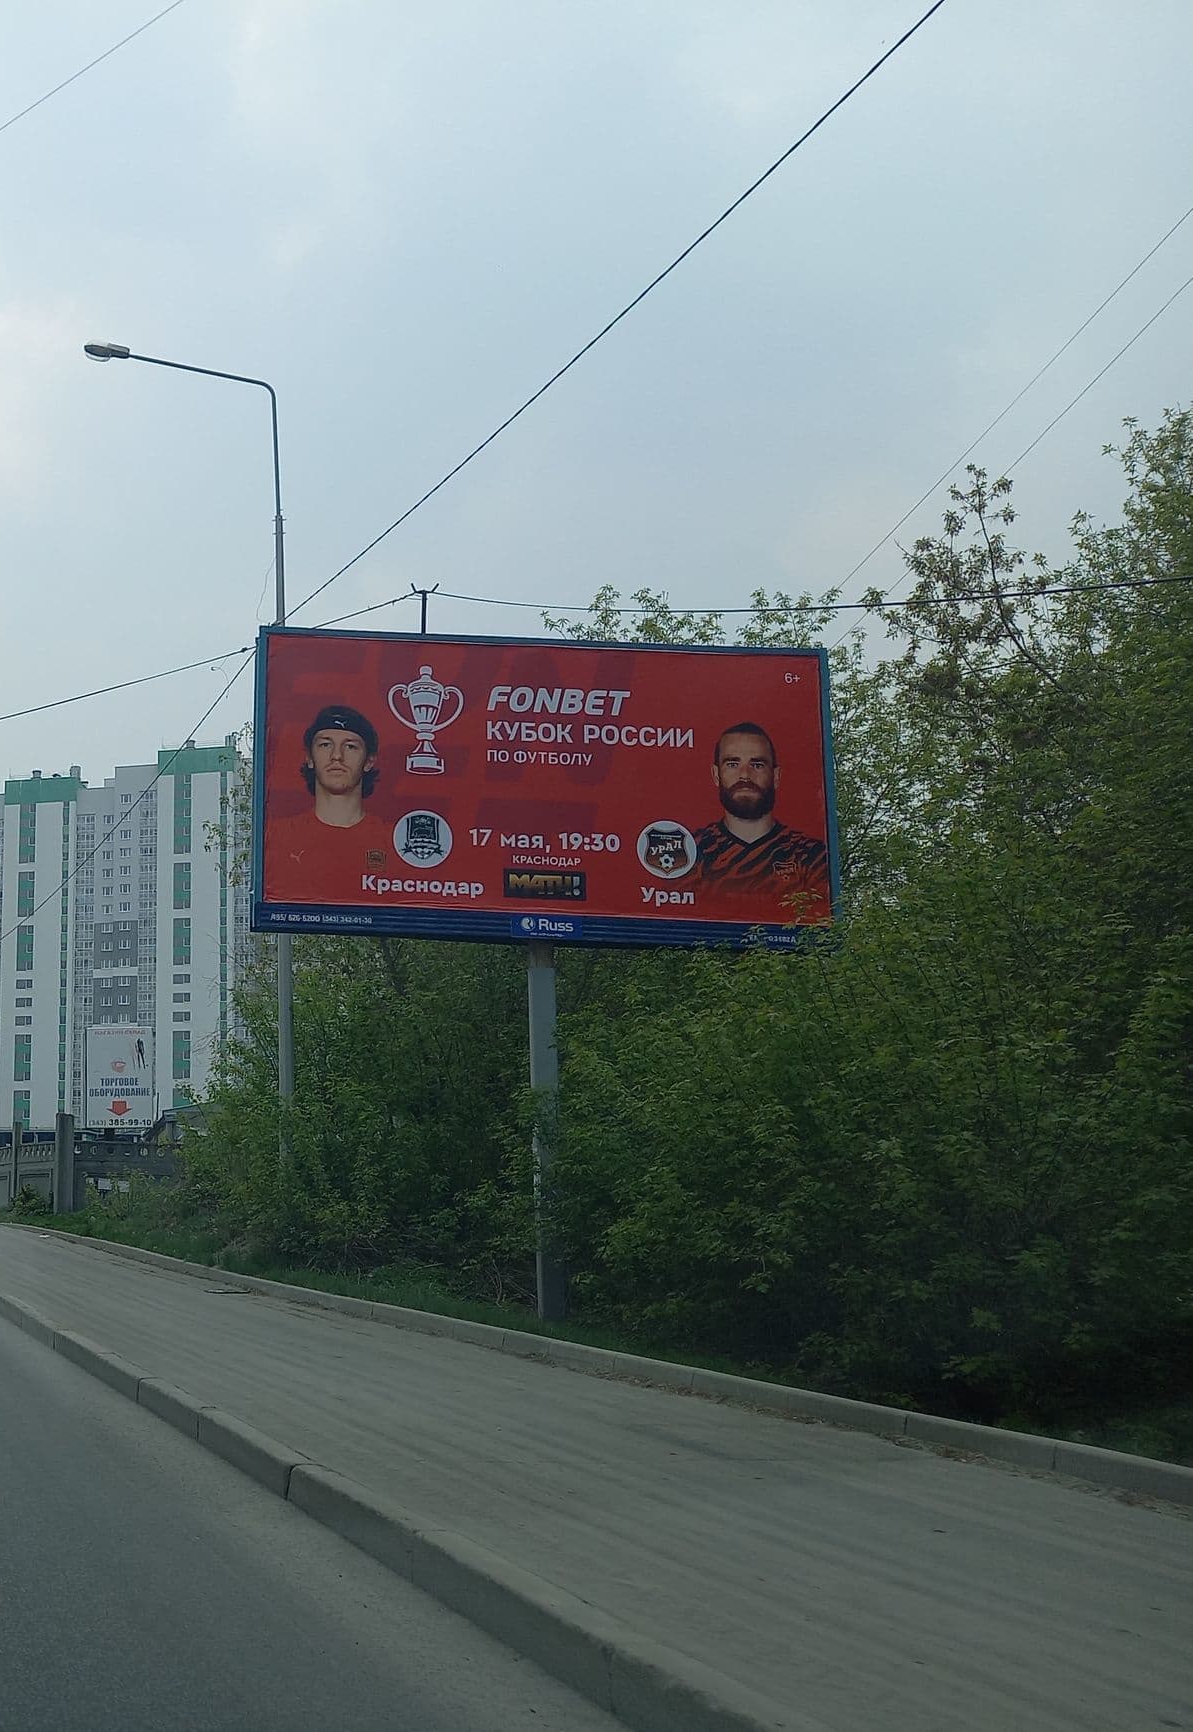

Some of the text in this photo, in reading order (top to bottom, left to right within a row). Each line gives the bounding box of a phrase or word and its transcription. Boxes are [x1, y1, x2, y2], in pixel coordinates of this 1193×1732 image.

[784, 672, 801, 684] 6+
[486, 685, 631, 716] FONBET
[486, 720, 695, 749] КУБОК РОССИИ
[486, 749, 593, 766] ПО ФУТБОЛУ
[469, 828, 621, 854] 17 мая, 19:30
[650, 840, 683, 856] УРАЛ
[512, 854, 581, 868] КРАСНОДАР
[361, 874, 484, 899] Краснодар
[640, 886, 695, 907] Урал
[538, 918, 574, 932] Russ
[100, 1077, 139, 1087] ТОРГОВОЕ
[89, 1087, 151, 1098] ОБОРУДОВАНИЕ
[108, 1118, 152, 1126] 385-99-10
